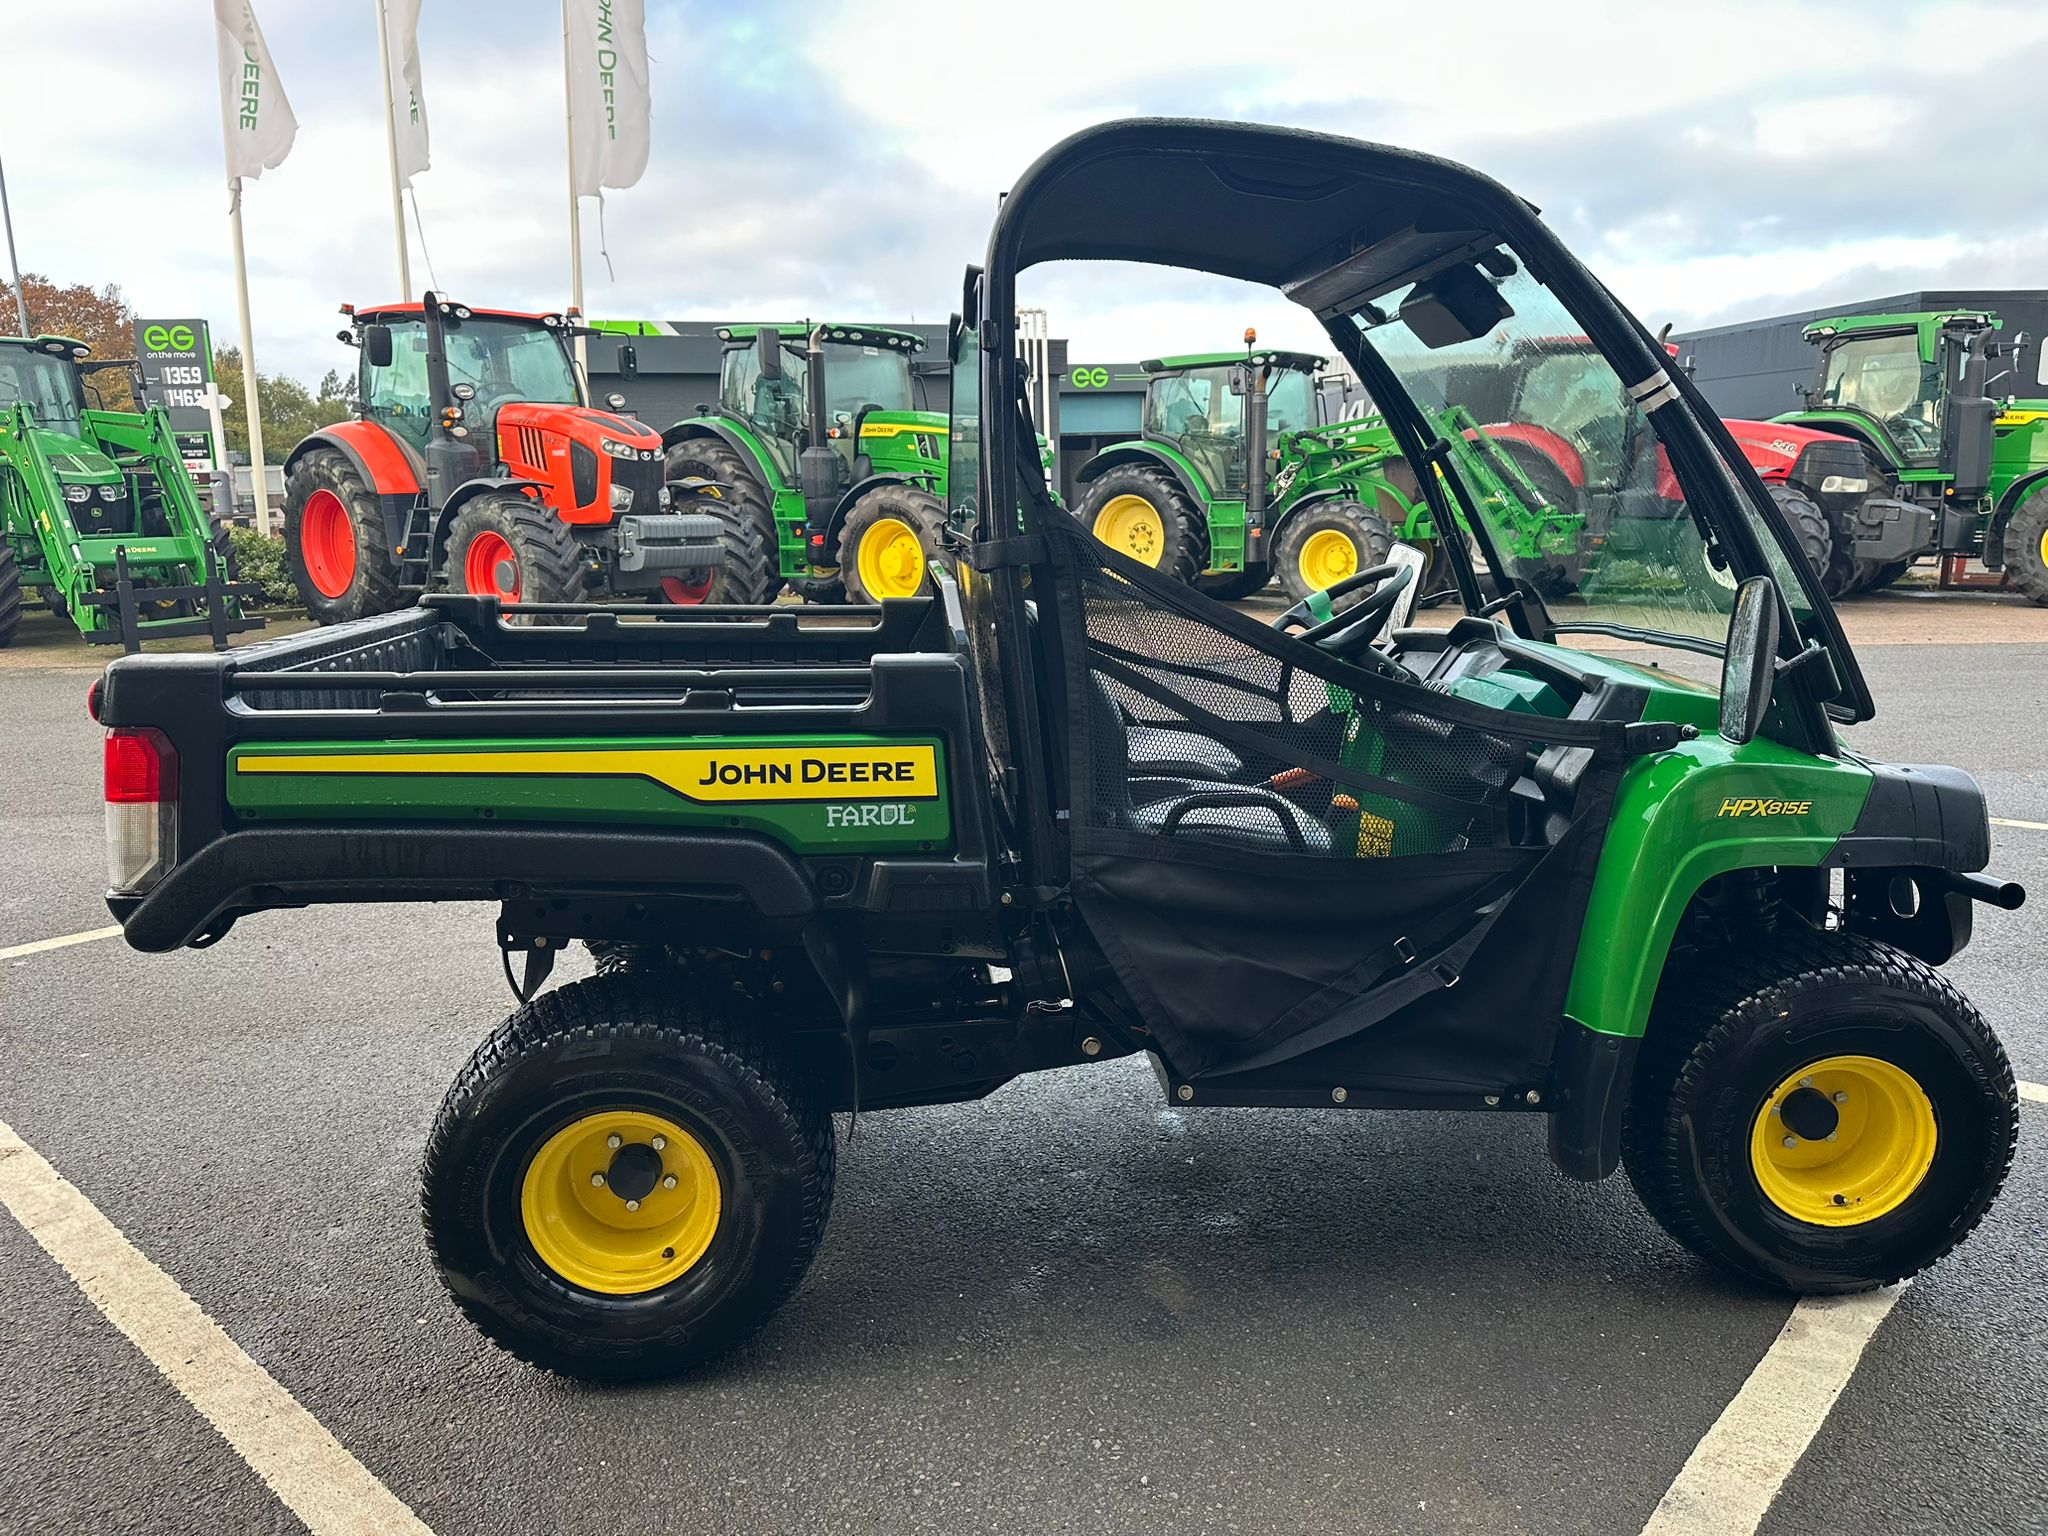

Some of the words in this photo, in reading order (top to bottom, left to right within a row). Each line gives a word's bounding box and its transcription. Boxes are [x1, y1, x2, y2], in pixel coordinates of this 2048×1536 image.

[159, 351, 172, 359] the
[699, 760, 792, 785] JOHN
[801, 759, 915, 783] DEERE
[826, 804, 915, 827] FAROL
[1717, 799, 1813, 817] HPX815E
